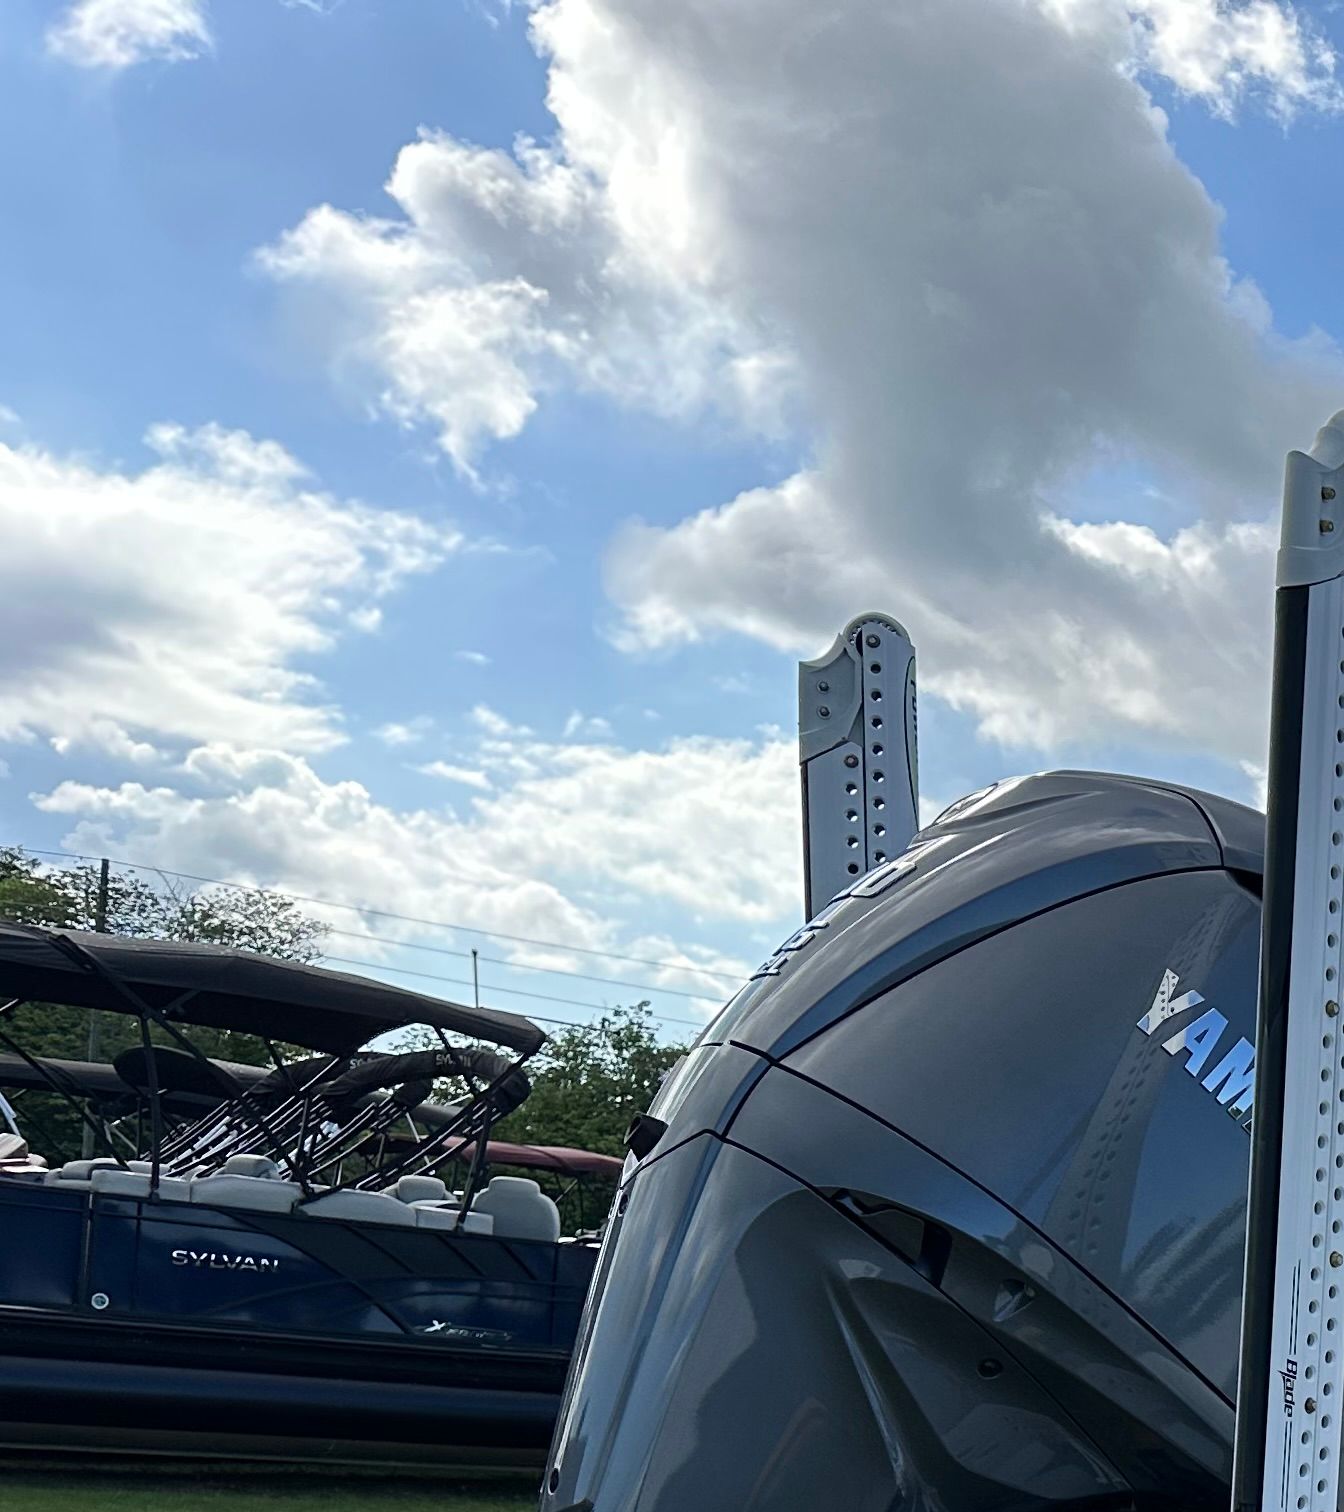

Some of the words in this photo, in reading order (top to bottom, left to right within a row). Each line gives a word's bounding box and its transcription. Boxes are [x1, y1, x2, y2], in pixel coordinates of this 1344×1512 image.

[1136, 968, 1256, 1136] YAM
[171, 1249, 279, 1273] SYLVAN
[1277, 1358, 1298, 1418] Blade
